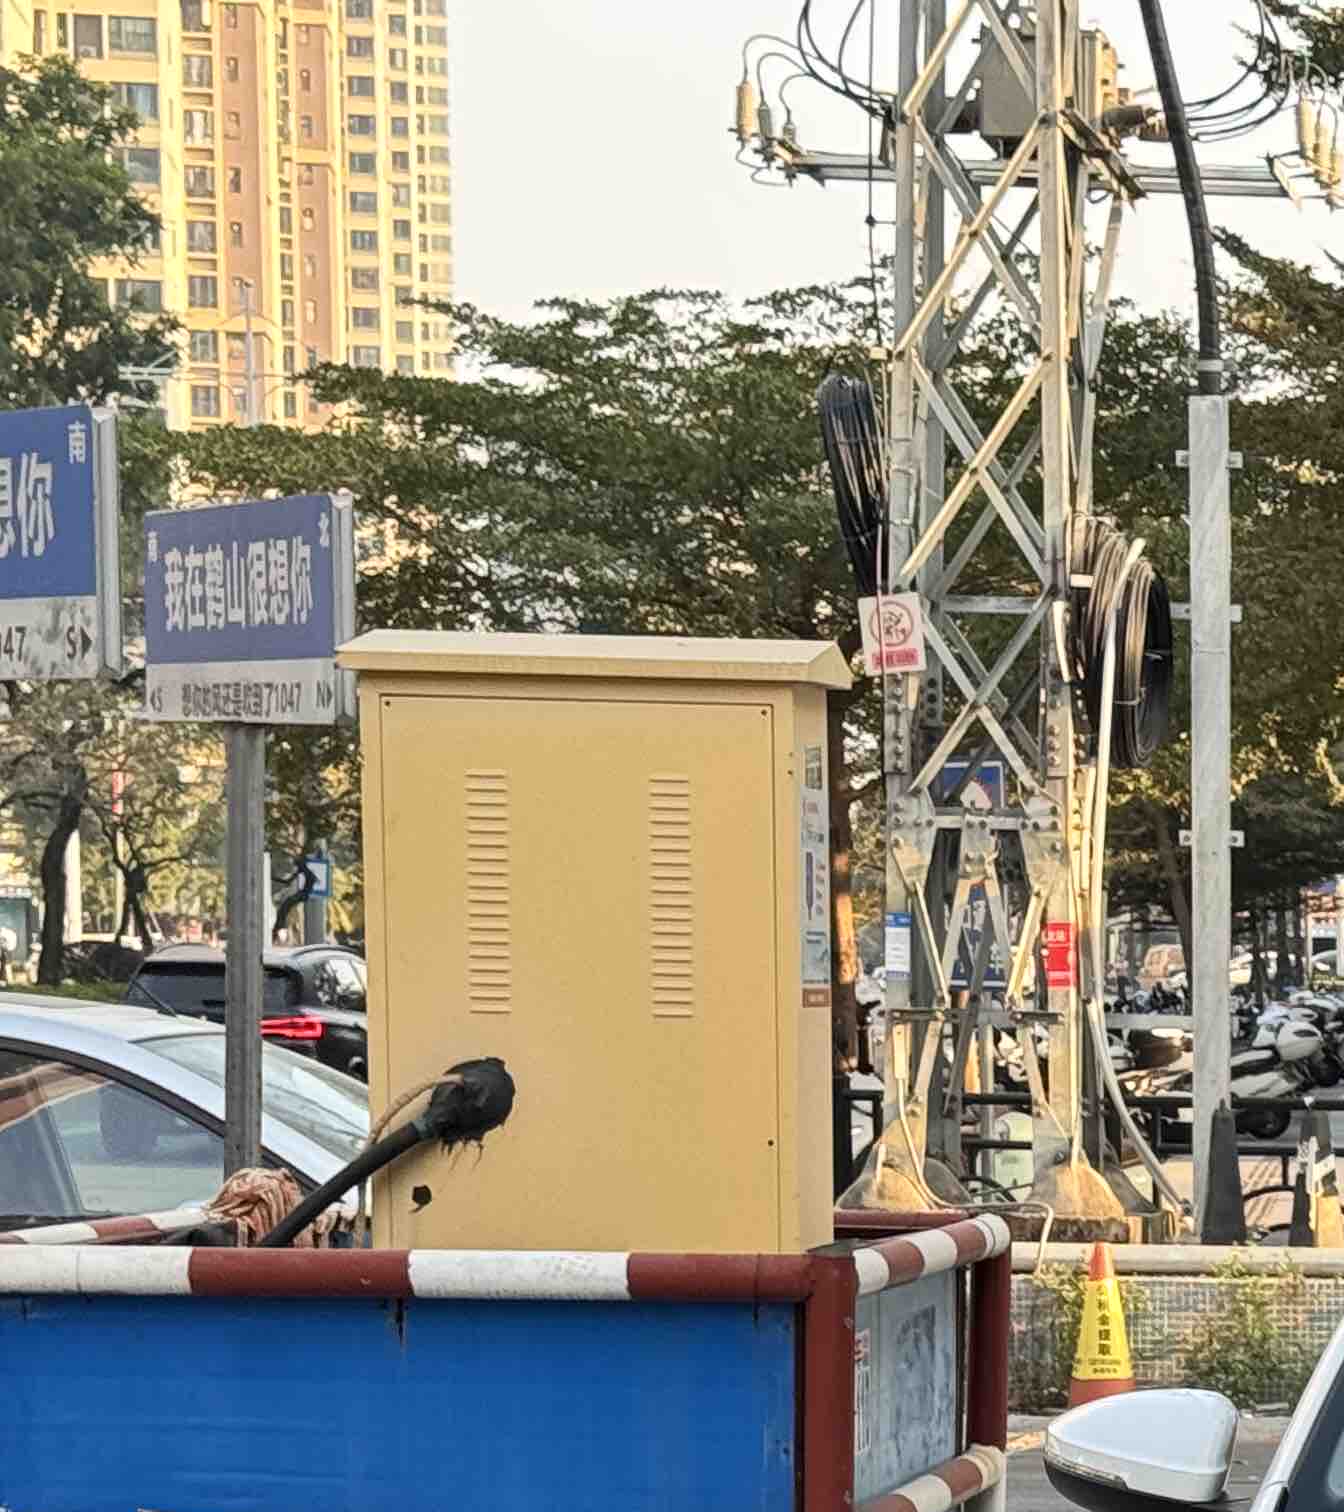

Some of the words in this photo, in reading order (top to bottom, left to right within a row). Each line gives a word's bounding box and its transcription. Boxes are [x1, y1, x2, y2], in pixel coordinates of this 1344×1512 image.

[68, 420, 87, 464] 南
[164, 535, 313, 632] 我在鹤山很想你
